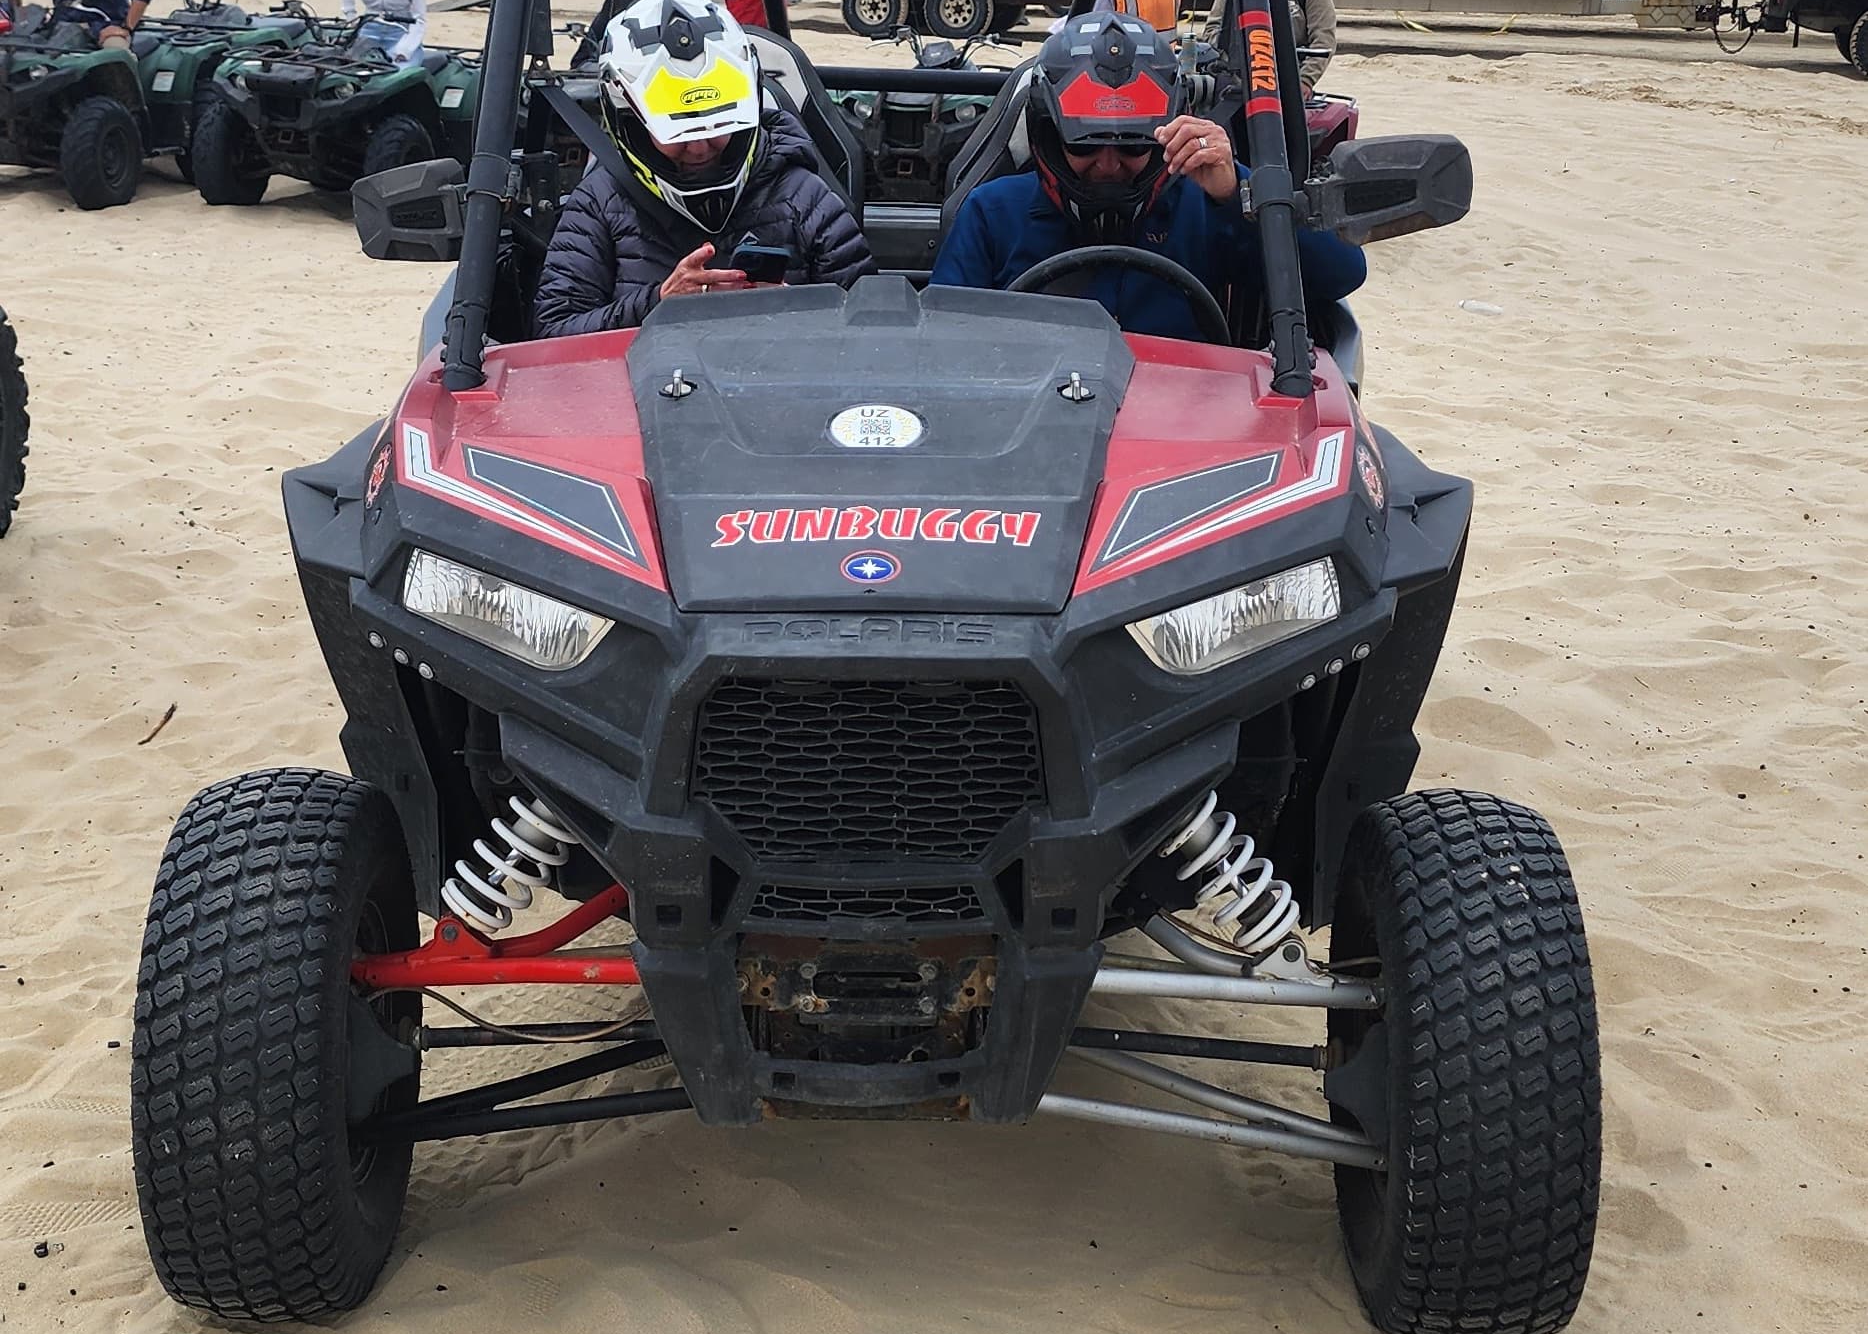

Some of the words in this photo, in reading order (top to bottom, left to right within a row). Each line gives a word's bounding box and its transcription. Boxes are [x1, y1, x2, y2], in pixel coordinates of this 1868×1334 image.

[1249, 29, 1277, 92] UZ412
[860, 408, 890, 418] UZ
[858, 436, 897, 447] 412
[711, 505, 1042, 548] SUNBUGGY
[742, 617, 994, 645] POLARIS
